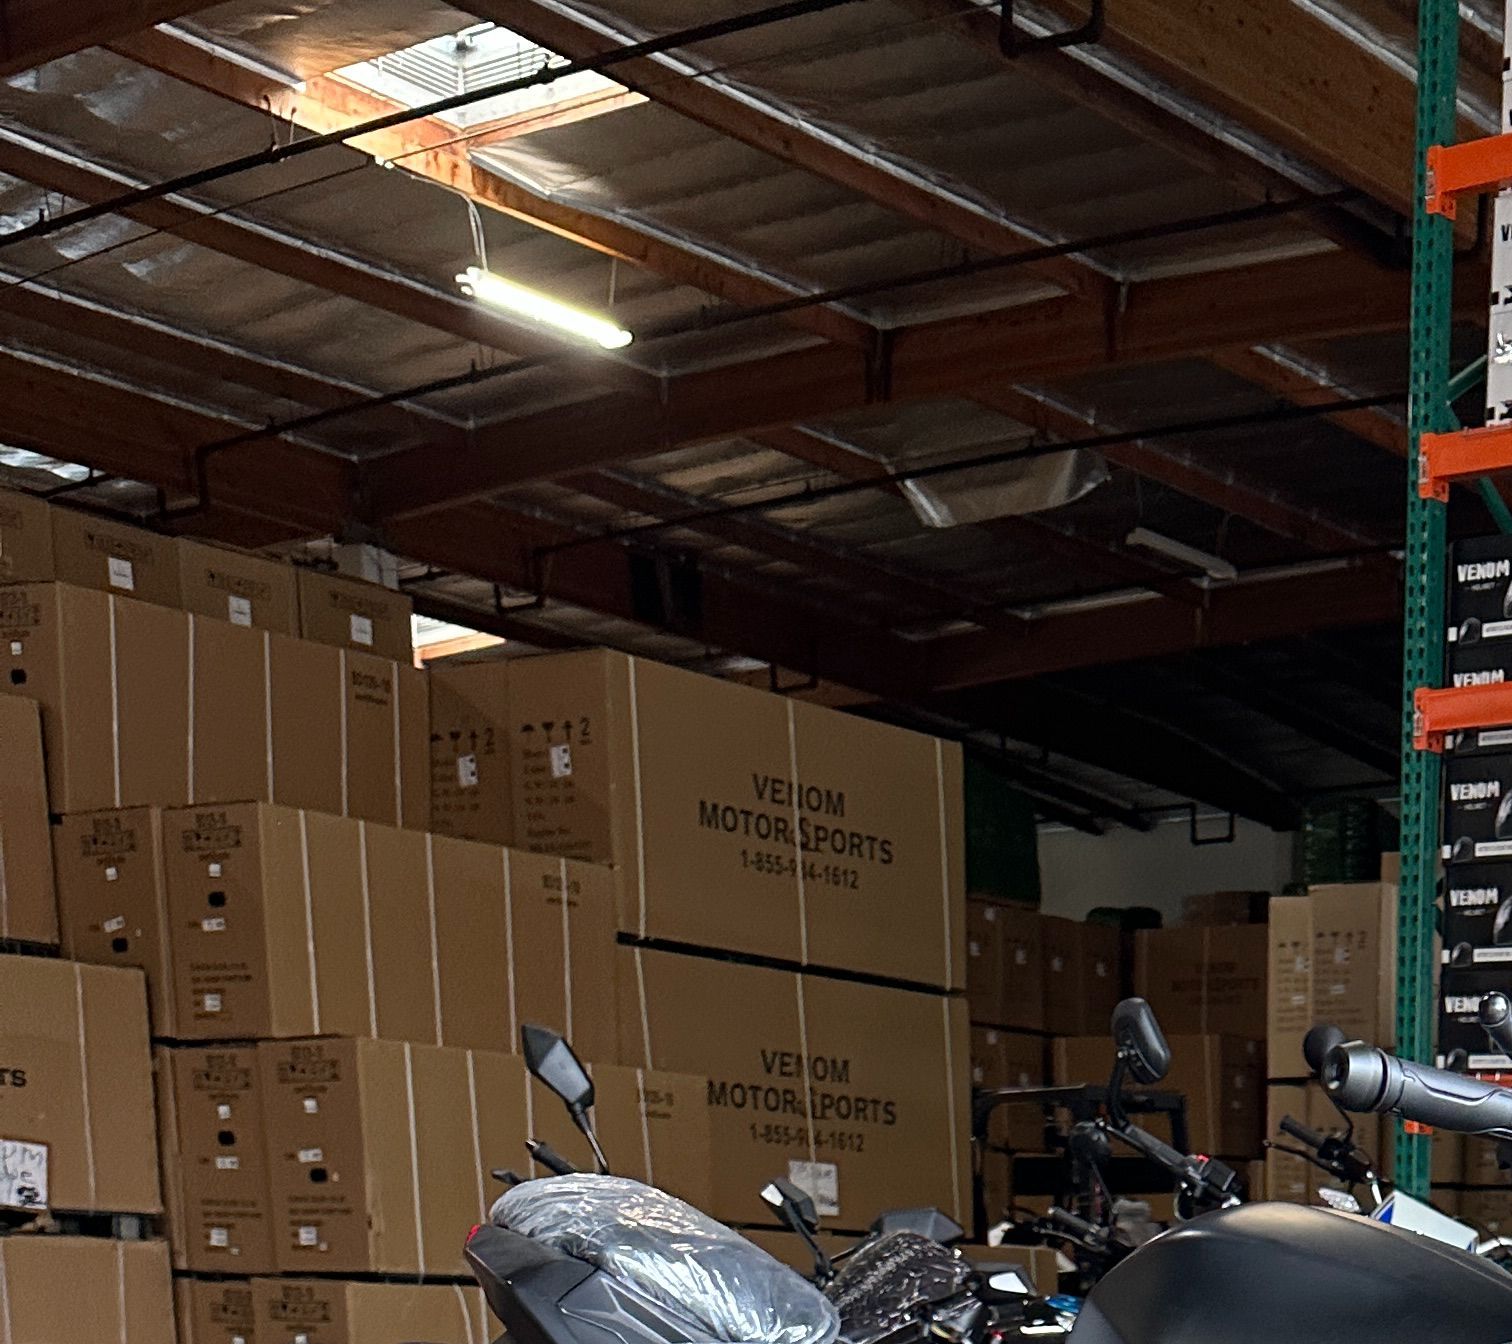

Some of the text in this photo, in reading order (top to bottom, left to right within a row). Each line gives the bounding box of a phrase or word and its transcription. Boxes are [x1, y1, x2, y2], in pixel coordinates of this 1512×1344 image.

[1457, 560, 1510, 582] VENOM
[1451, 781, 1500, 801] VENOM
[1450, 888, 1498, 907] VENOM
[1445, 996, 1479, 1012] VENO
